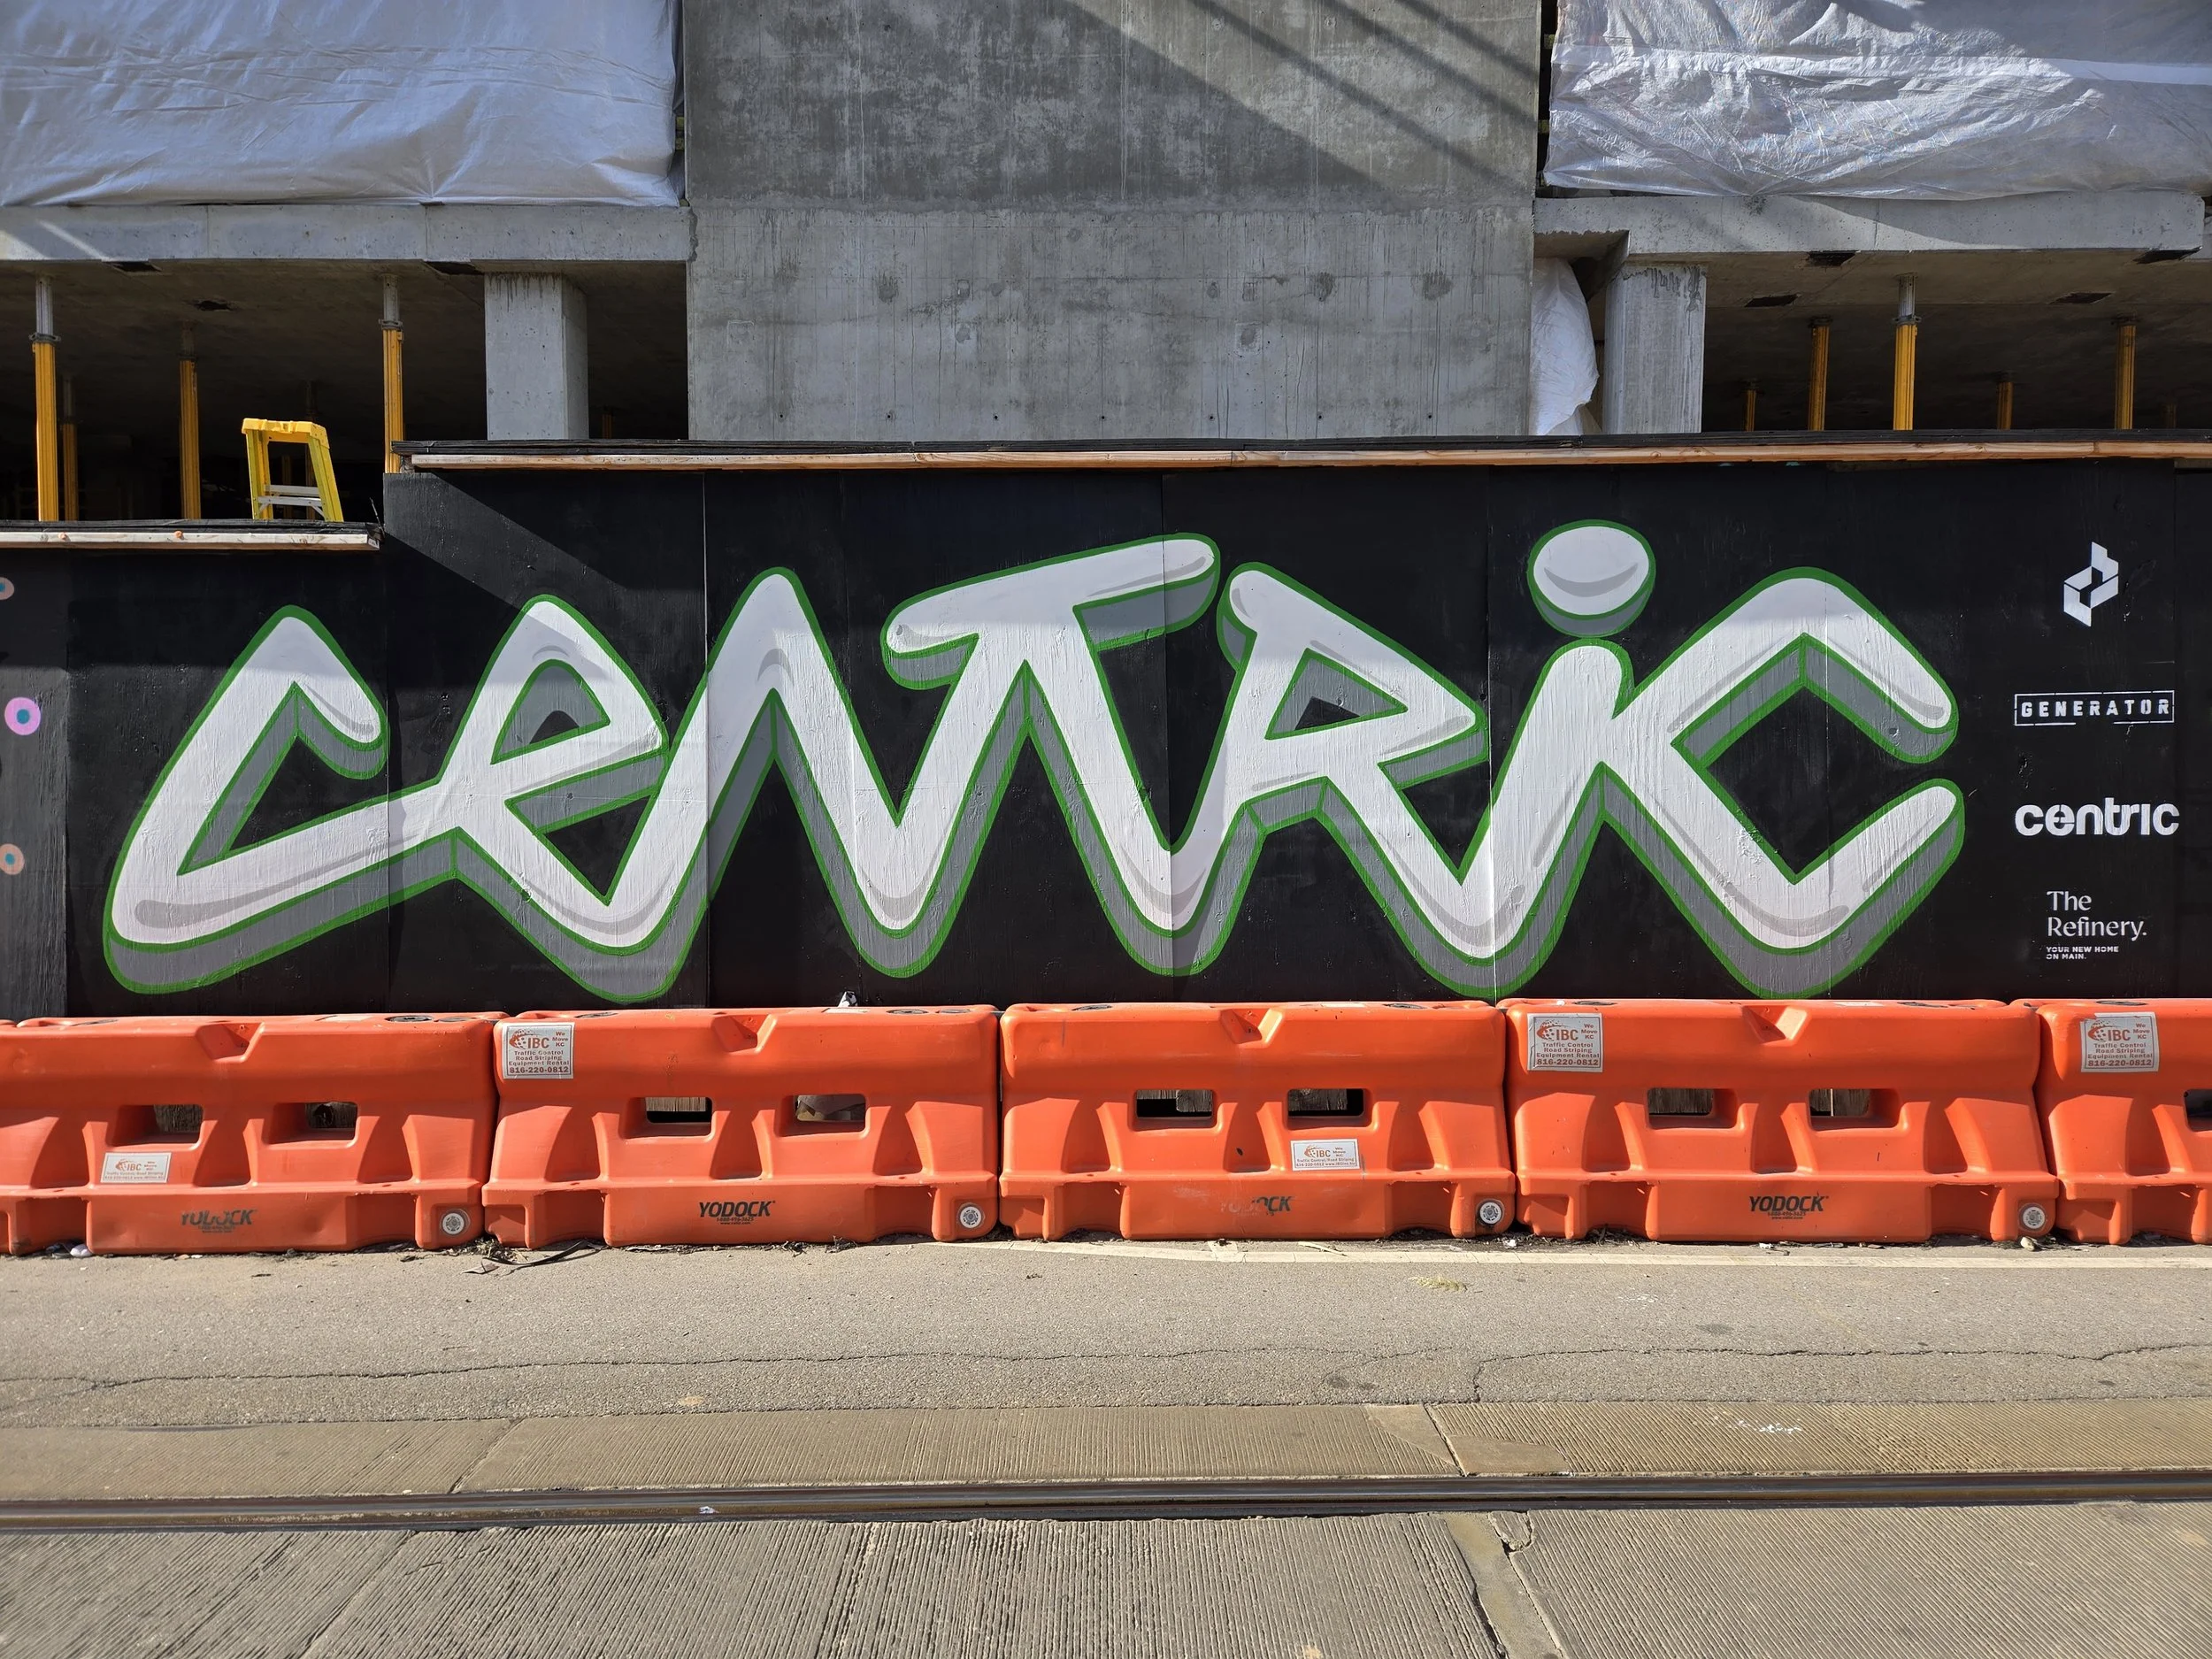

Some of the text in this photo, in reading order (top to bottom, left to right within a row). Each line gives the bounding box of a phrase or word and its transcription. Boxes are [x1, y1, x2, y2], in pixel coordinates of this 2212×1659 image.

[2020, 698, 2170, 718] GENERATOR
[2014, 797, 2180, 836] centric
[2046, 890, 2093, 911] The
[2047, 916, 2147, 941] Refinery.
[527, 1037, 549, 1048] IBC
[1555, 1029, 1578, 1041] IBC
[2108, 1029, 2131, 1041] IBC
[698, 1202, 772, 1217] YODOCK
[1749, 1195, 1824, 1212] YODOCK
